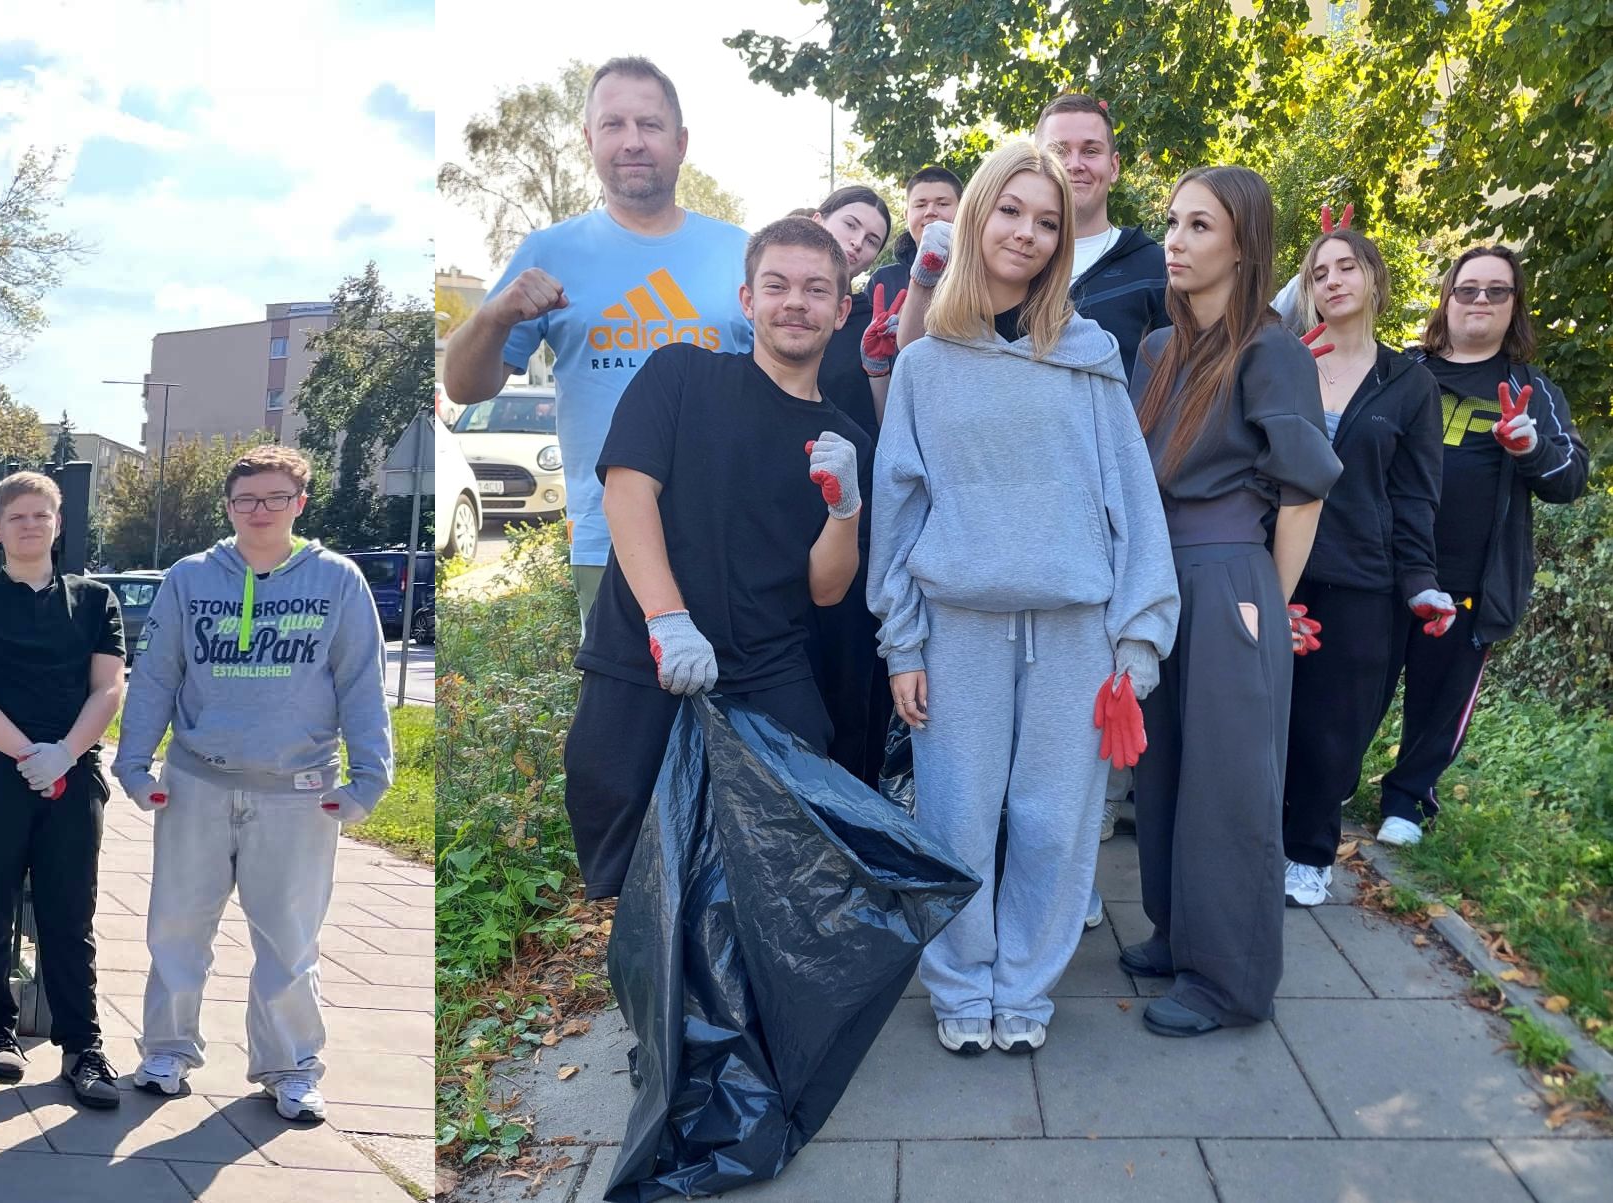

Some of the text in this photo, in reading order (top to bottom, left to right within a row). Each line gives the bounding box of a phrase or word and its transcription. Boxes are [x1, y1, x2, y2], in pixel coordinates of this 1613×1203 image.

[589, 319, 722, 351] adidas
[591, 357, 637, 370] REAL
[255, 627, 320, 663] Park
[211, 664, 292, 678] ESTABLISHED
